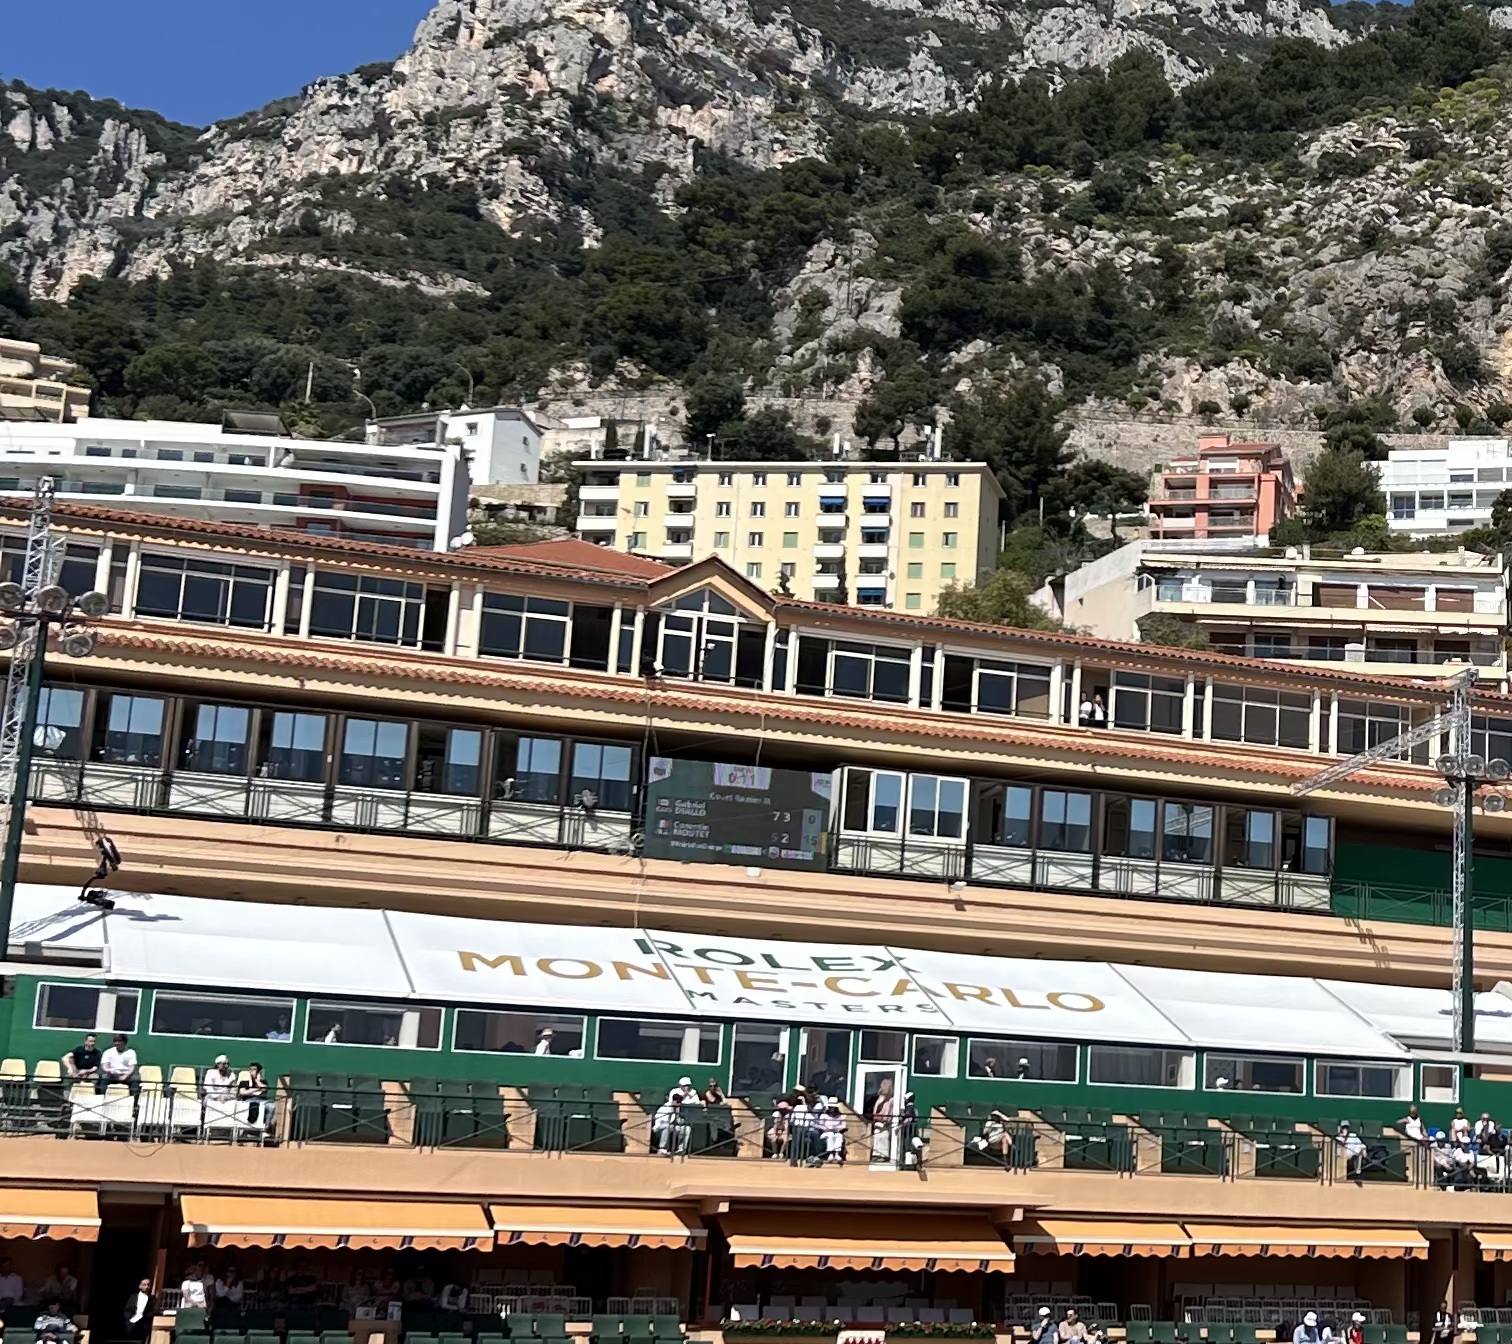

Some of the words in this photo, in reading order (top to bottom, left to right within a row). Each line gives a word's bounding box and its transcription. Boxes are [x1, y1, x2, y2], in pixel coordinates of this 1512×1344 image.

[781, 833, 790, 844] 2
[633, 938, 922, 973] ROLEX
[455, 950, 1107, 1014] MONTE-CARLO
[684, 988, 940, 1014] MASTERS
